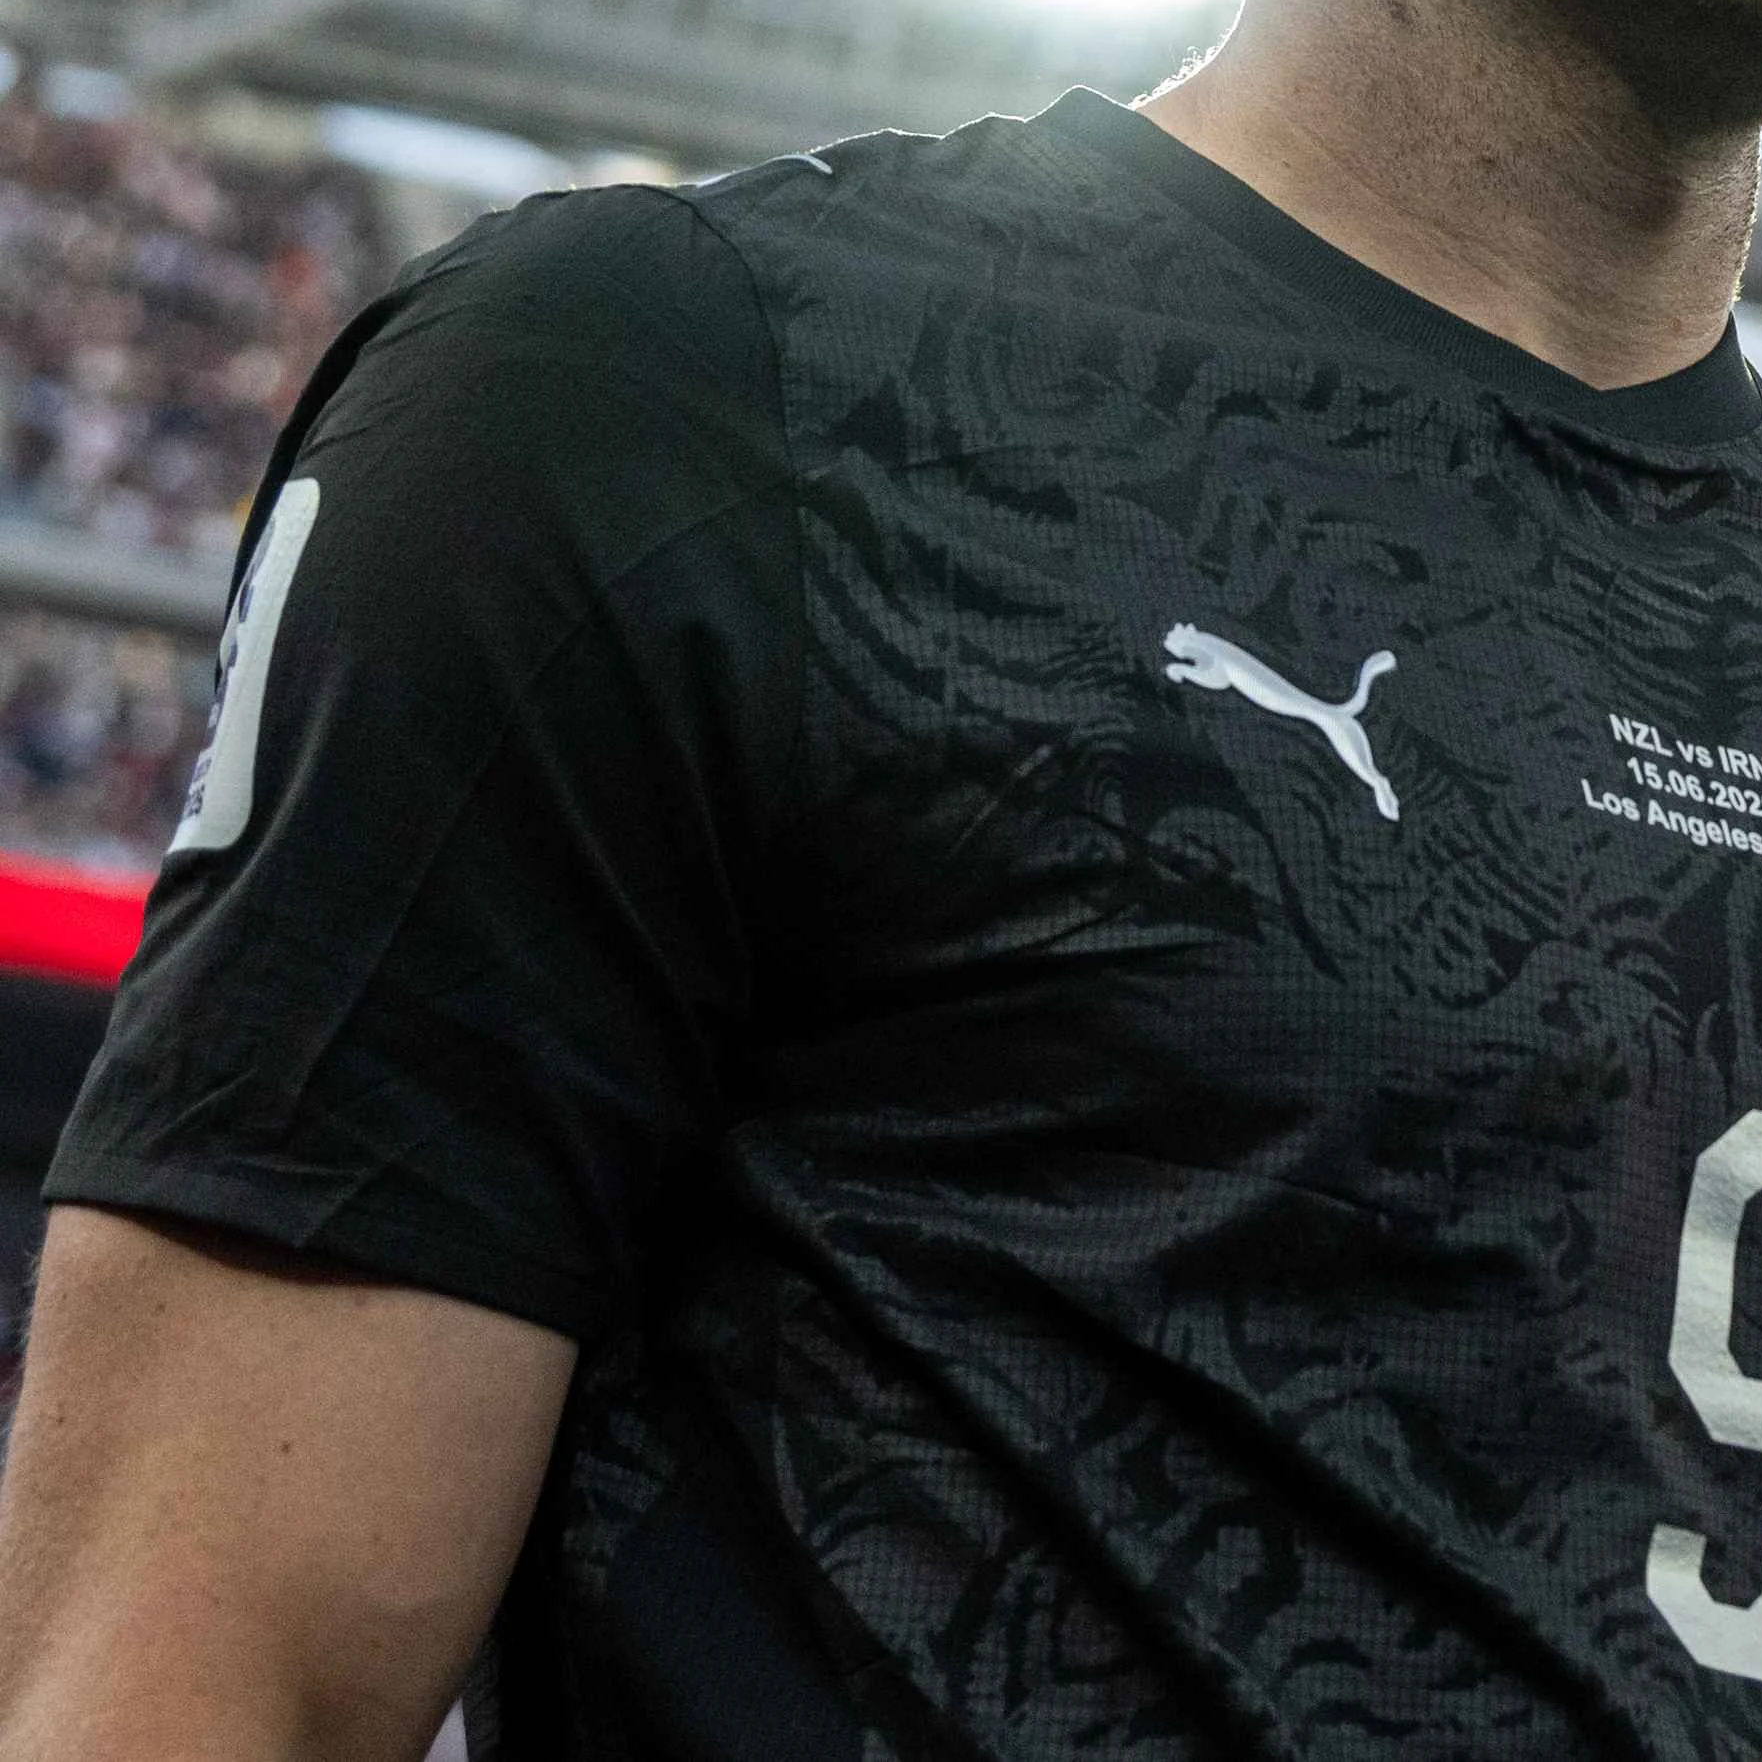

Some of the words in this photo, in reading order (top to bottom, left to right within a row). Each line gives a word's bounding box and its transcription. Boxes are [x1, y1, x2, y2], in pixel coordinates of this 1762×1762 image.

[1608, 713, 1674, 758] NZL
[1675, 740, 1714, 769] vs
[1580, 778, 1641, 822] Los
